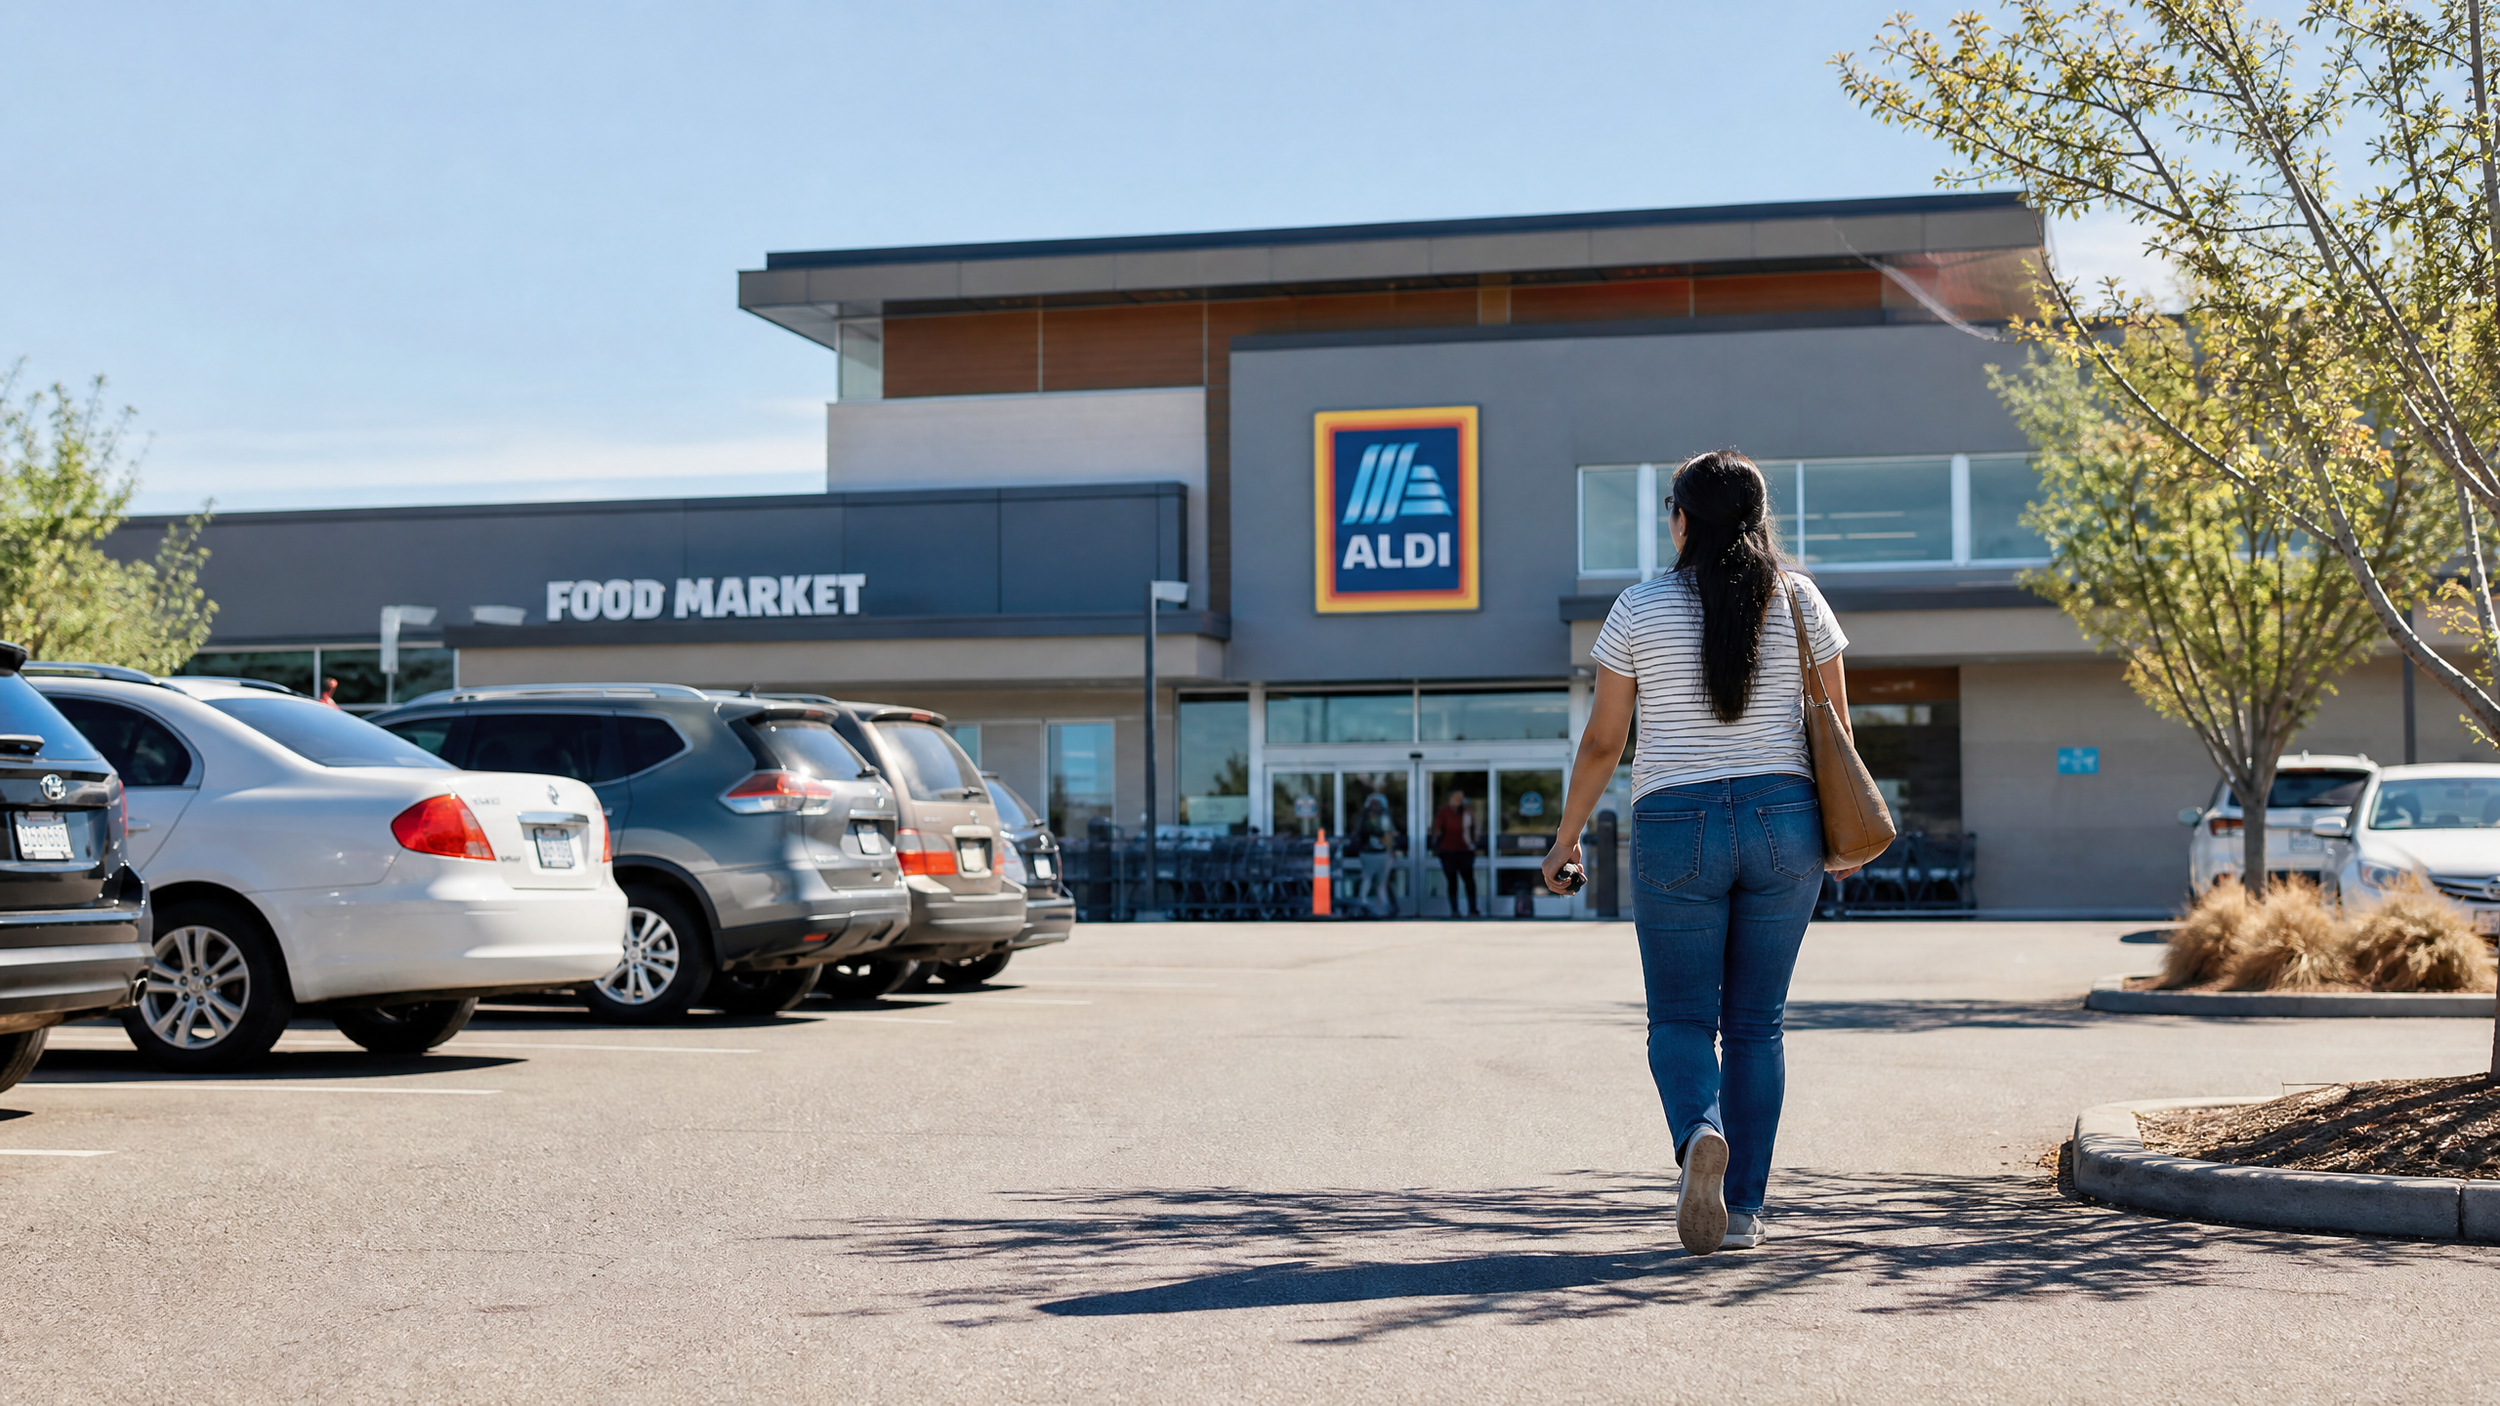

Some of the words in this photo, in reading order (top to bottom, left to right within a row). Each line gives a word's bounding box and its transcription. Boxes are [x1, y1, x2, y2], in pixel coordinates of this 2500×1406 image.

[1342, 532, 1451, 569] ALDI
[546, 579, 665, 621] FOOD
[674, 573, 867, 619] MARKET
